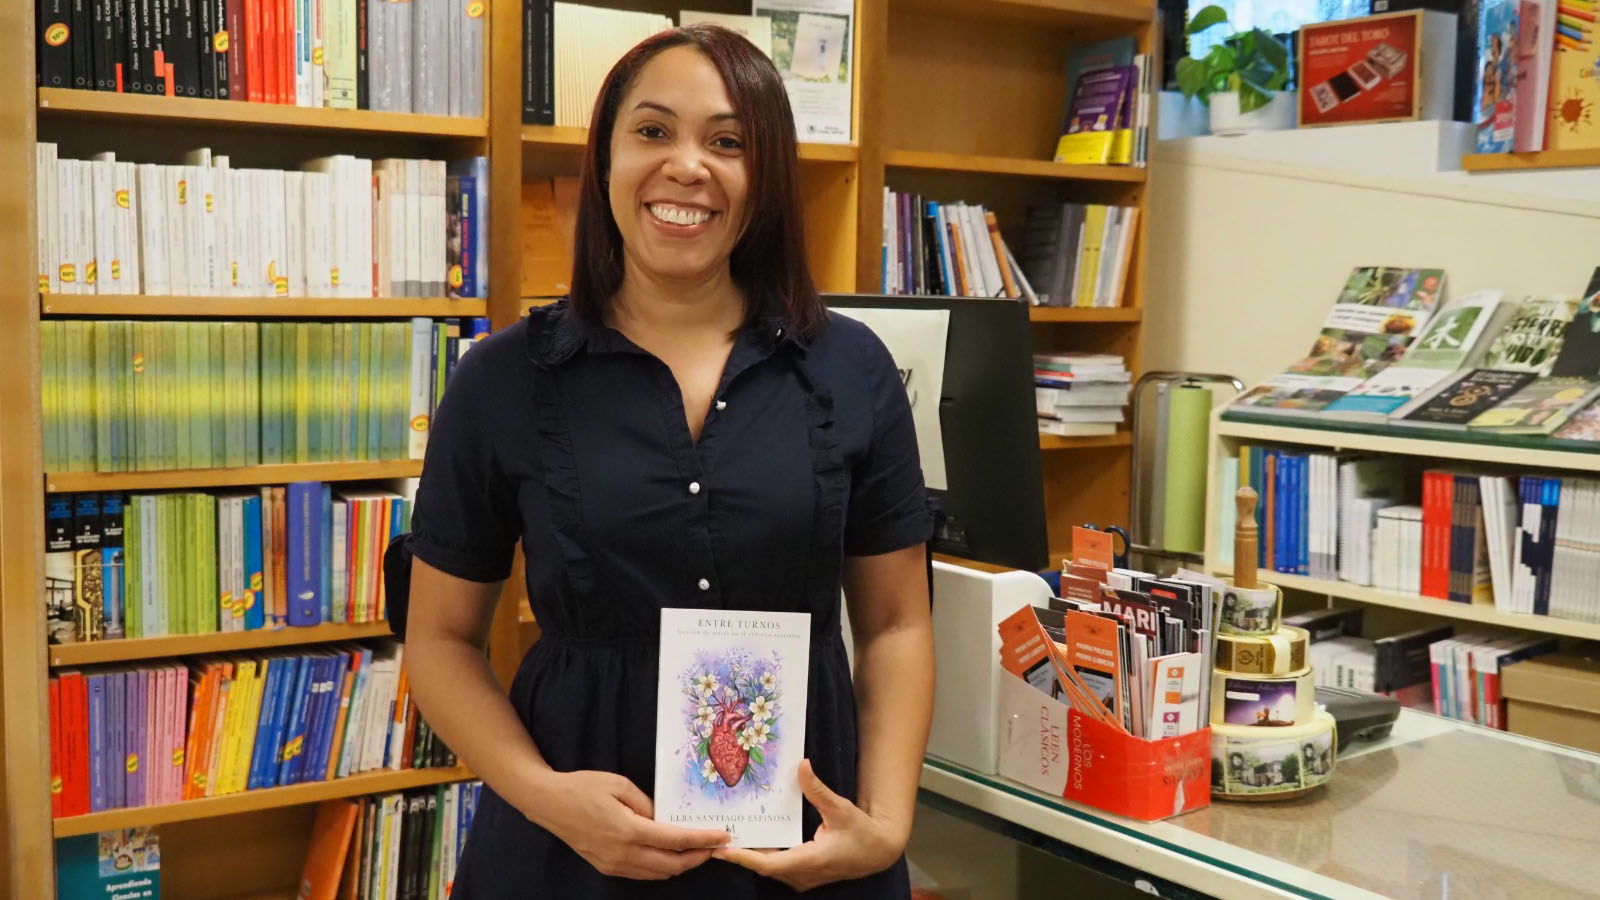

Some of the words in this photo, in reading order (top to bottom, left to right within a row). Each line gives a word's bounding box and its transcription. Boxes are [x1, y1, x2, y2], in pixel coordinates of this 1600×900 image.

[1340, 32, 1358, 44] DEL
[1362, 28, 1390, 42] TORO
[698, 618, 733, 628] ENTRE
[738, 620, 781, 630] TURNOS
[1050, 724, 1060, 764] LEEN
[1072, 715, 1082, 790] MODERNOS
[1082, 743, 1092, 768] LOS
[696, 814, 744, 822] SANTIAGO
[748, 814, 792, 822] ESPINOSA
